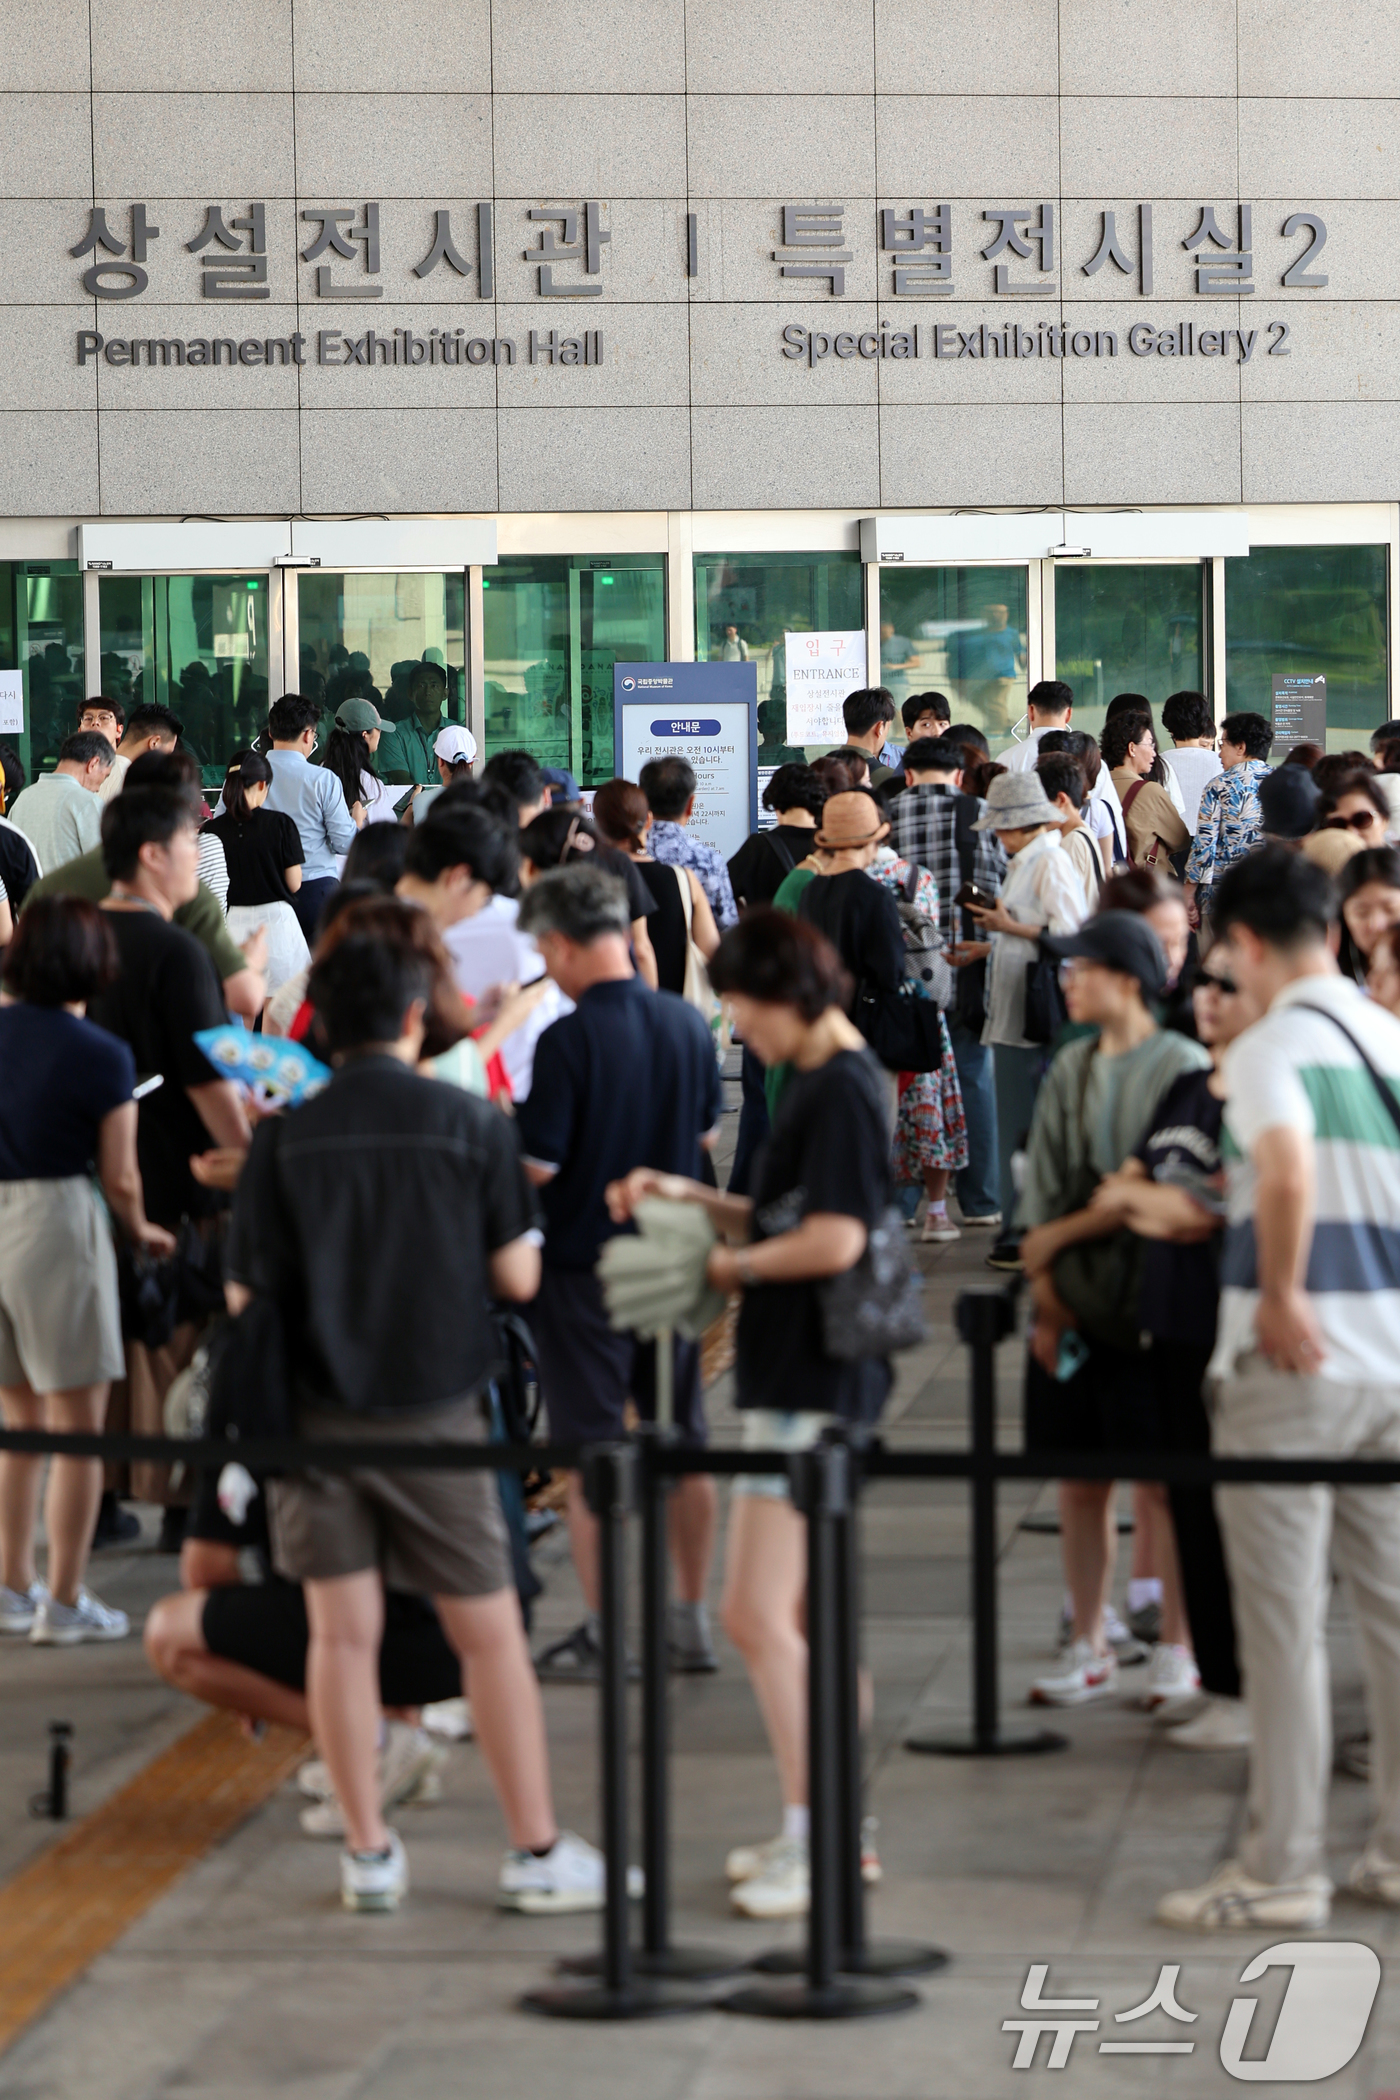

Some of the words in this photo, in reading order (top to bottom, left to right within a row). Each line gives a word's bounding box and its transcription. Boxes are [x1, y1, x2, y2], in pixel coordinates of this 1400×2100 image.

[70, 202, 611, 299] 상설전시관
[76, 331, 307, 366] Permanent
[319, 328, 517, 366] Exhibition
[530, 329, 605, 366] Hall
[782, 321, 922, 367] Special
[934, 321, 1118, 359] Exhibition
[1129, 321, 1259, 365] Gallery
[1267, 321, 1292, 356] 2
[793, 667, 860, 680] ENTRANCE
[0, 690, 17, 700] 다시
[806, 688, 846, 699] 상설전시관
[670, 721, 701, 733] 안내문
[637, 746, 652, 755] 우리
[654, 745, 685, 755] 전시관은
[686, 745, 701, 755] 오전
[703, 745, 735, 754] 10시부터
[691, 755, 723, 765] 있습니다.
